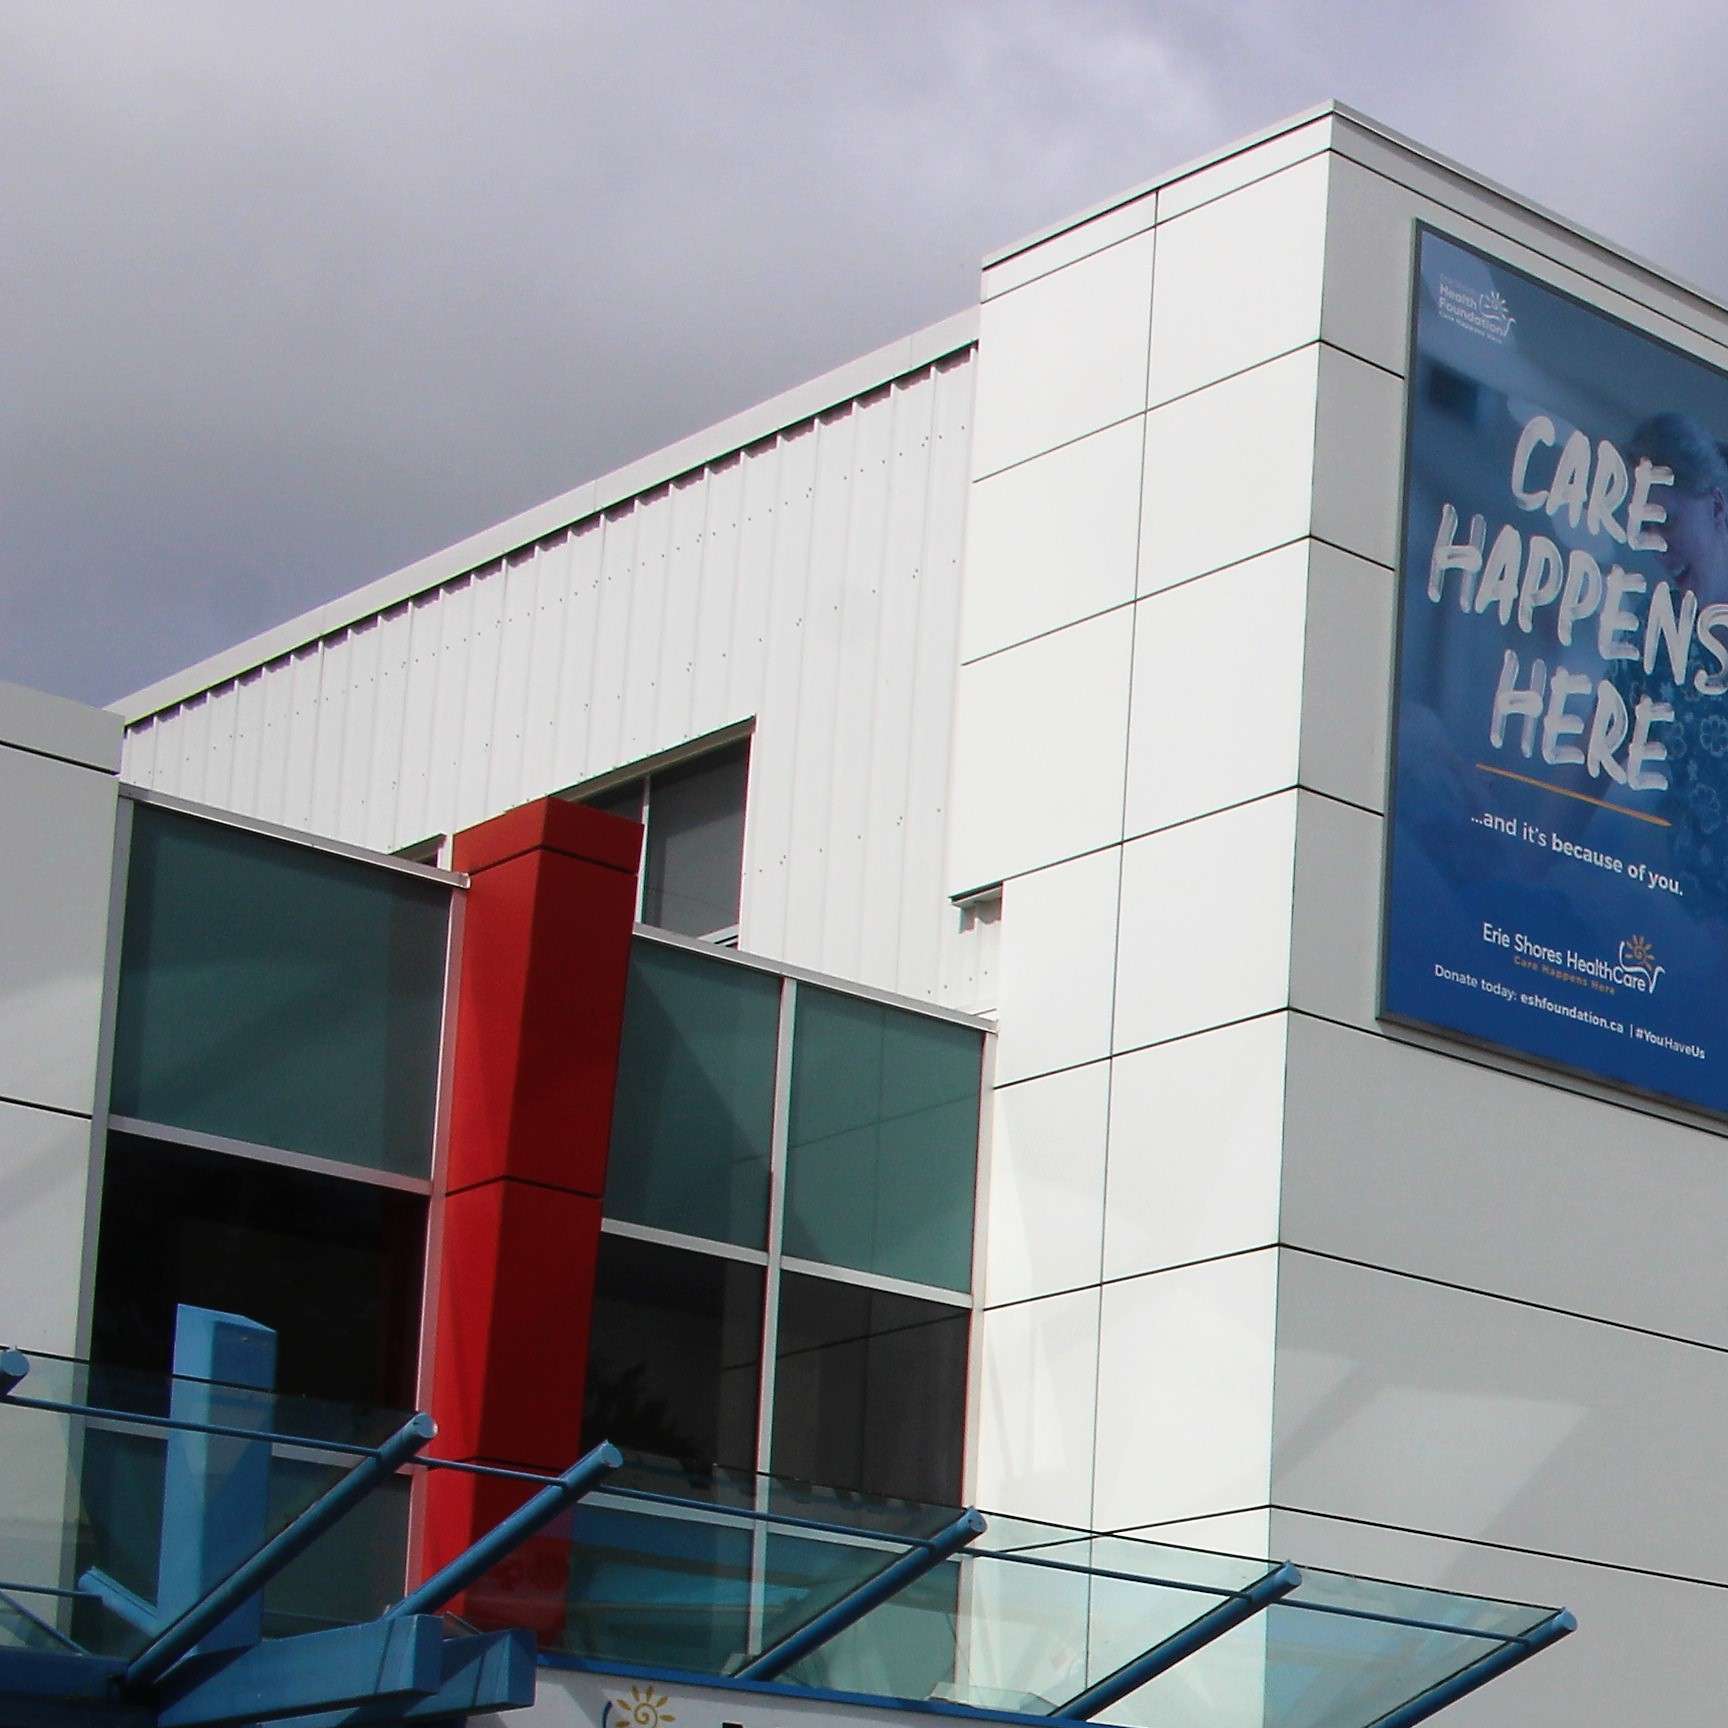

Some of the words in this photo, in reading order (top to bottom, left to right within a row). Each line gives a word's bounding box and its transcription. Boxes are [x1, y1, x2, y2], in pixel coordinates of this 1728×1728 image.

[1511, 416, 1675, 552] CARE
[1490, 649, 1675, 791] HERE
[1471, 812, 1517, 836] ...and
[1522, 822, 1548, 847] it's
[1551, 833, 1623, 873] because
[1627, 864, 1647, 881] of
[1648, 871, 1684, 896] you.
[1434, 964, 1478, 989] Donate
[1481, 980, 1517, 1001] today:
[1520, 992, 1624, 1034] eshfoundation.ca
[1482, 922, 1511, 948] Erie
[1514, 933, 1563, 965] Shores
[1567, 950, 1647, 992] HealthCare
